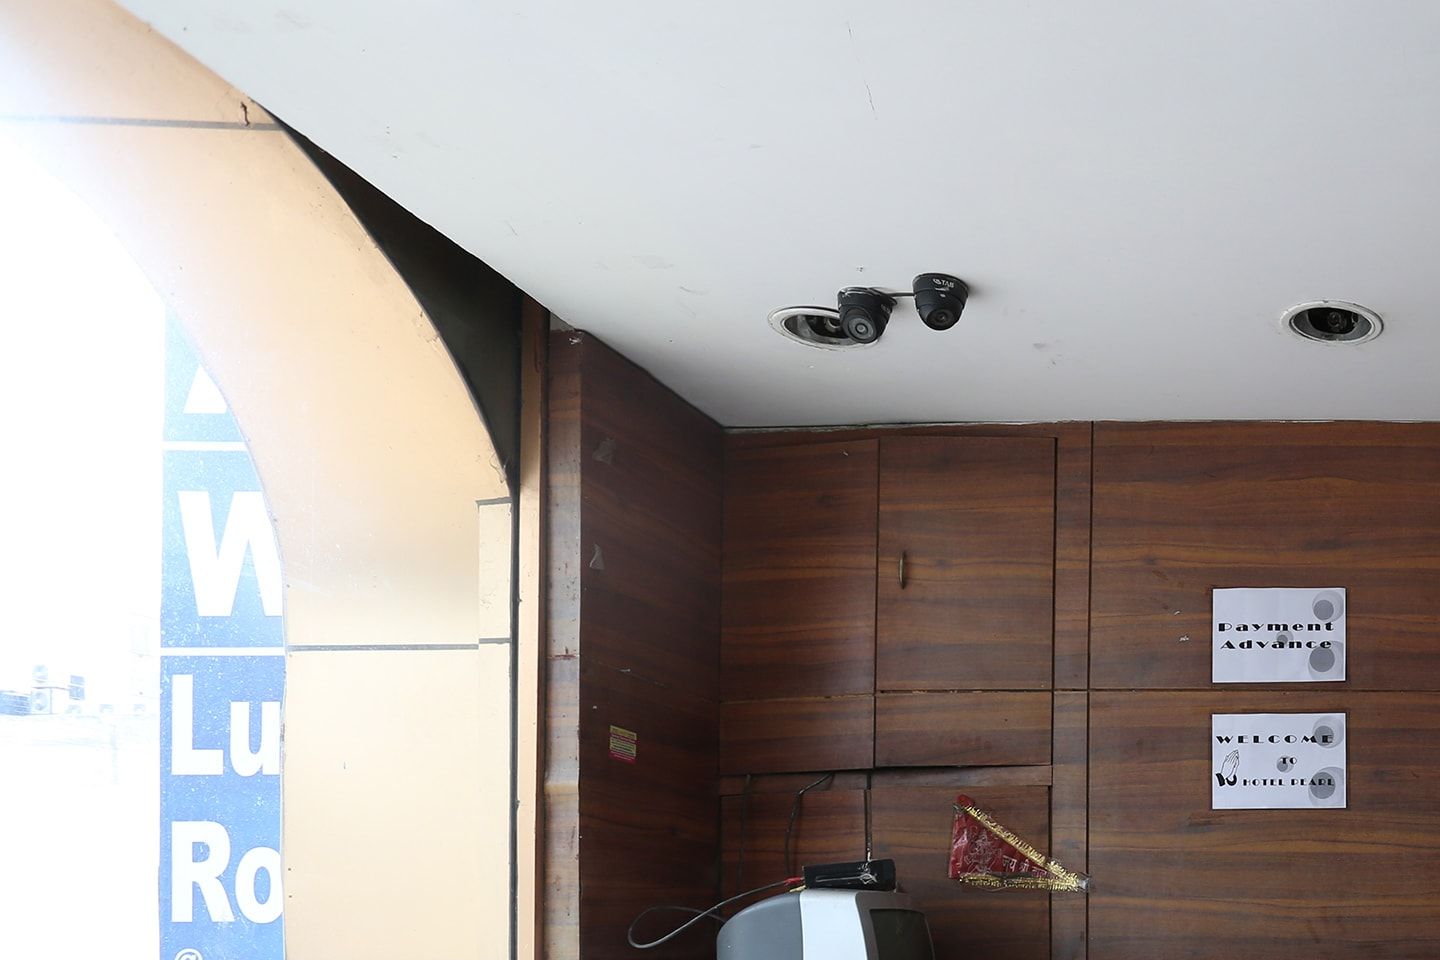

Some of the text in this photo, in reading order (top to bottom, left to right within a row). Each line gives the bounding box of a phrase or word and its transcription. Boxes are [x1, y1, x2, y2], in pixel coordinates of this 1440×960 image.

[1218, 621, 1334, 632] Payment
[1220, 640, 1332, 649] Advance
[171, 674, 281, 777] Lu
[1216, 735, 1333, 744] WELCOME
[1243, 778, 1335, 786] HOTEL PEARL
[171, 821, 283, 924] Ro
